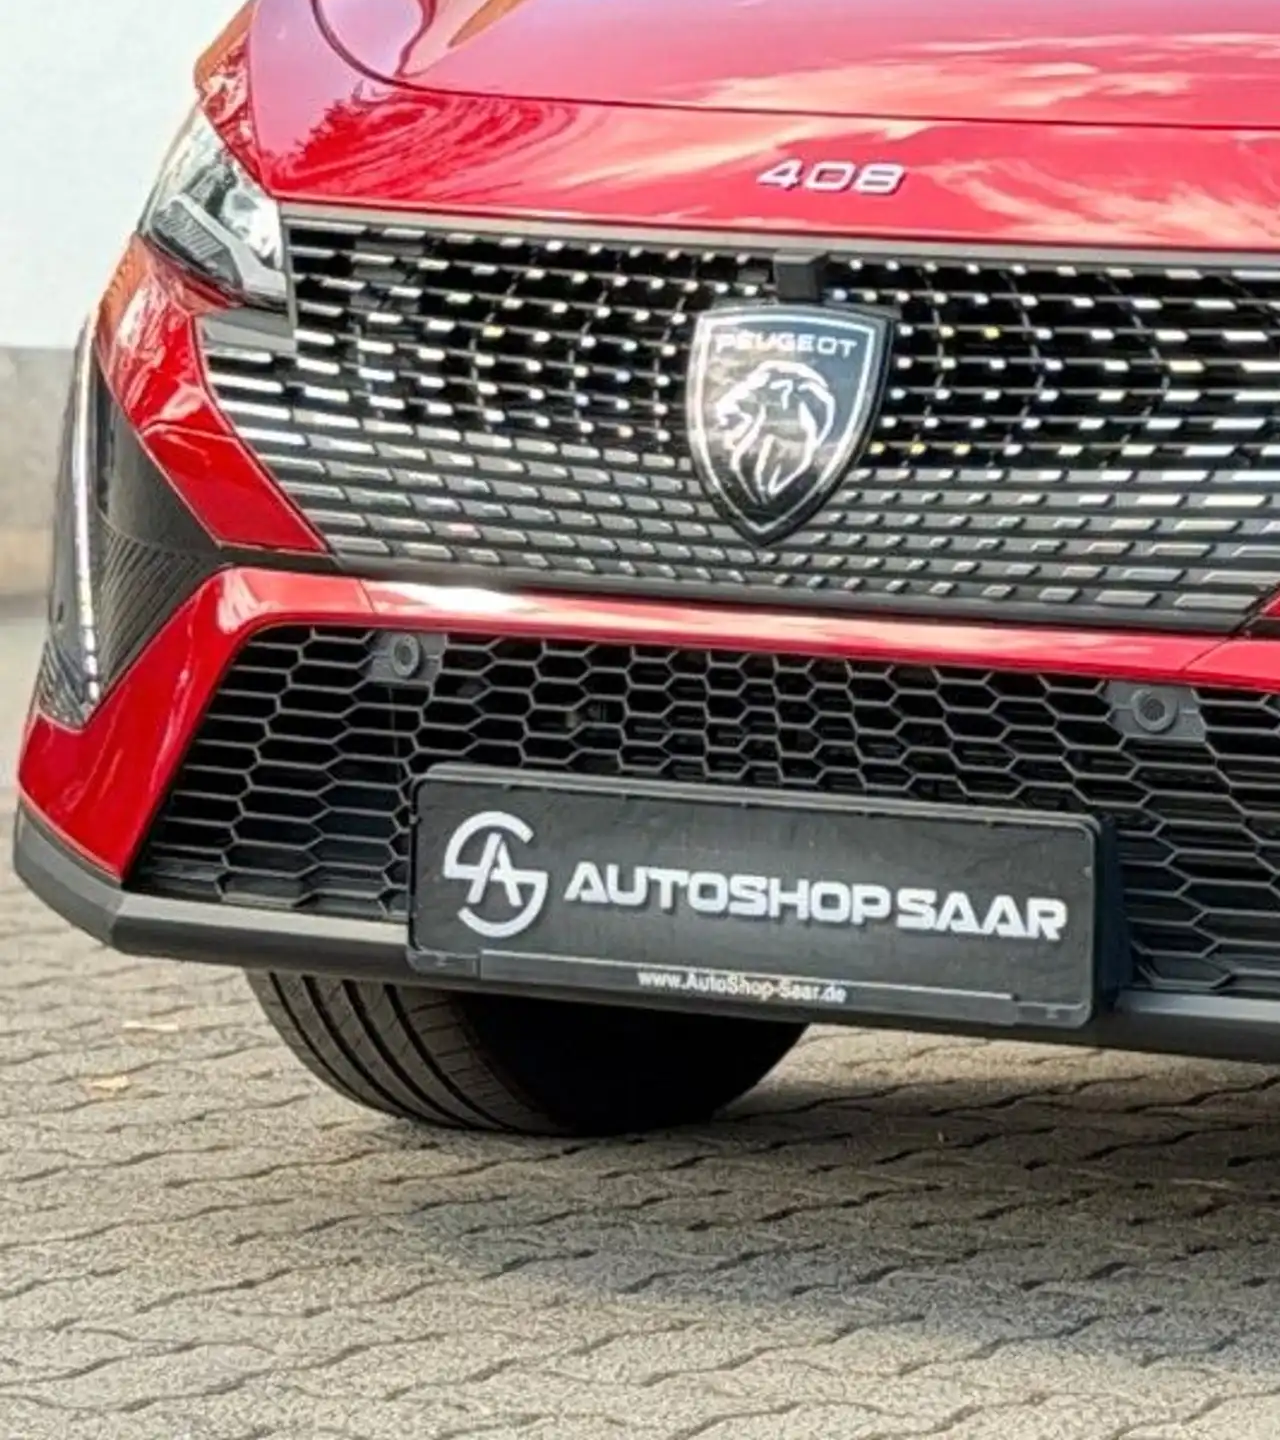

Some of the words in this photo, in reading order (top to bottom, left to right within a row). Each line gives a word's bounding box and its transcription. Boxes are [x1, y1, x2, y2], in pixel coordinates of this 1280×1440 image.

[757, 160, 906, 194] 408
[715, 330, 857, 358] PEUGEOT
[637, 971, 848, 1004] www.AutoShop-Saar.de
